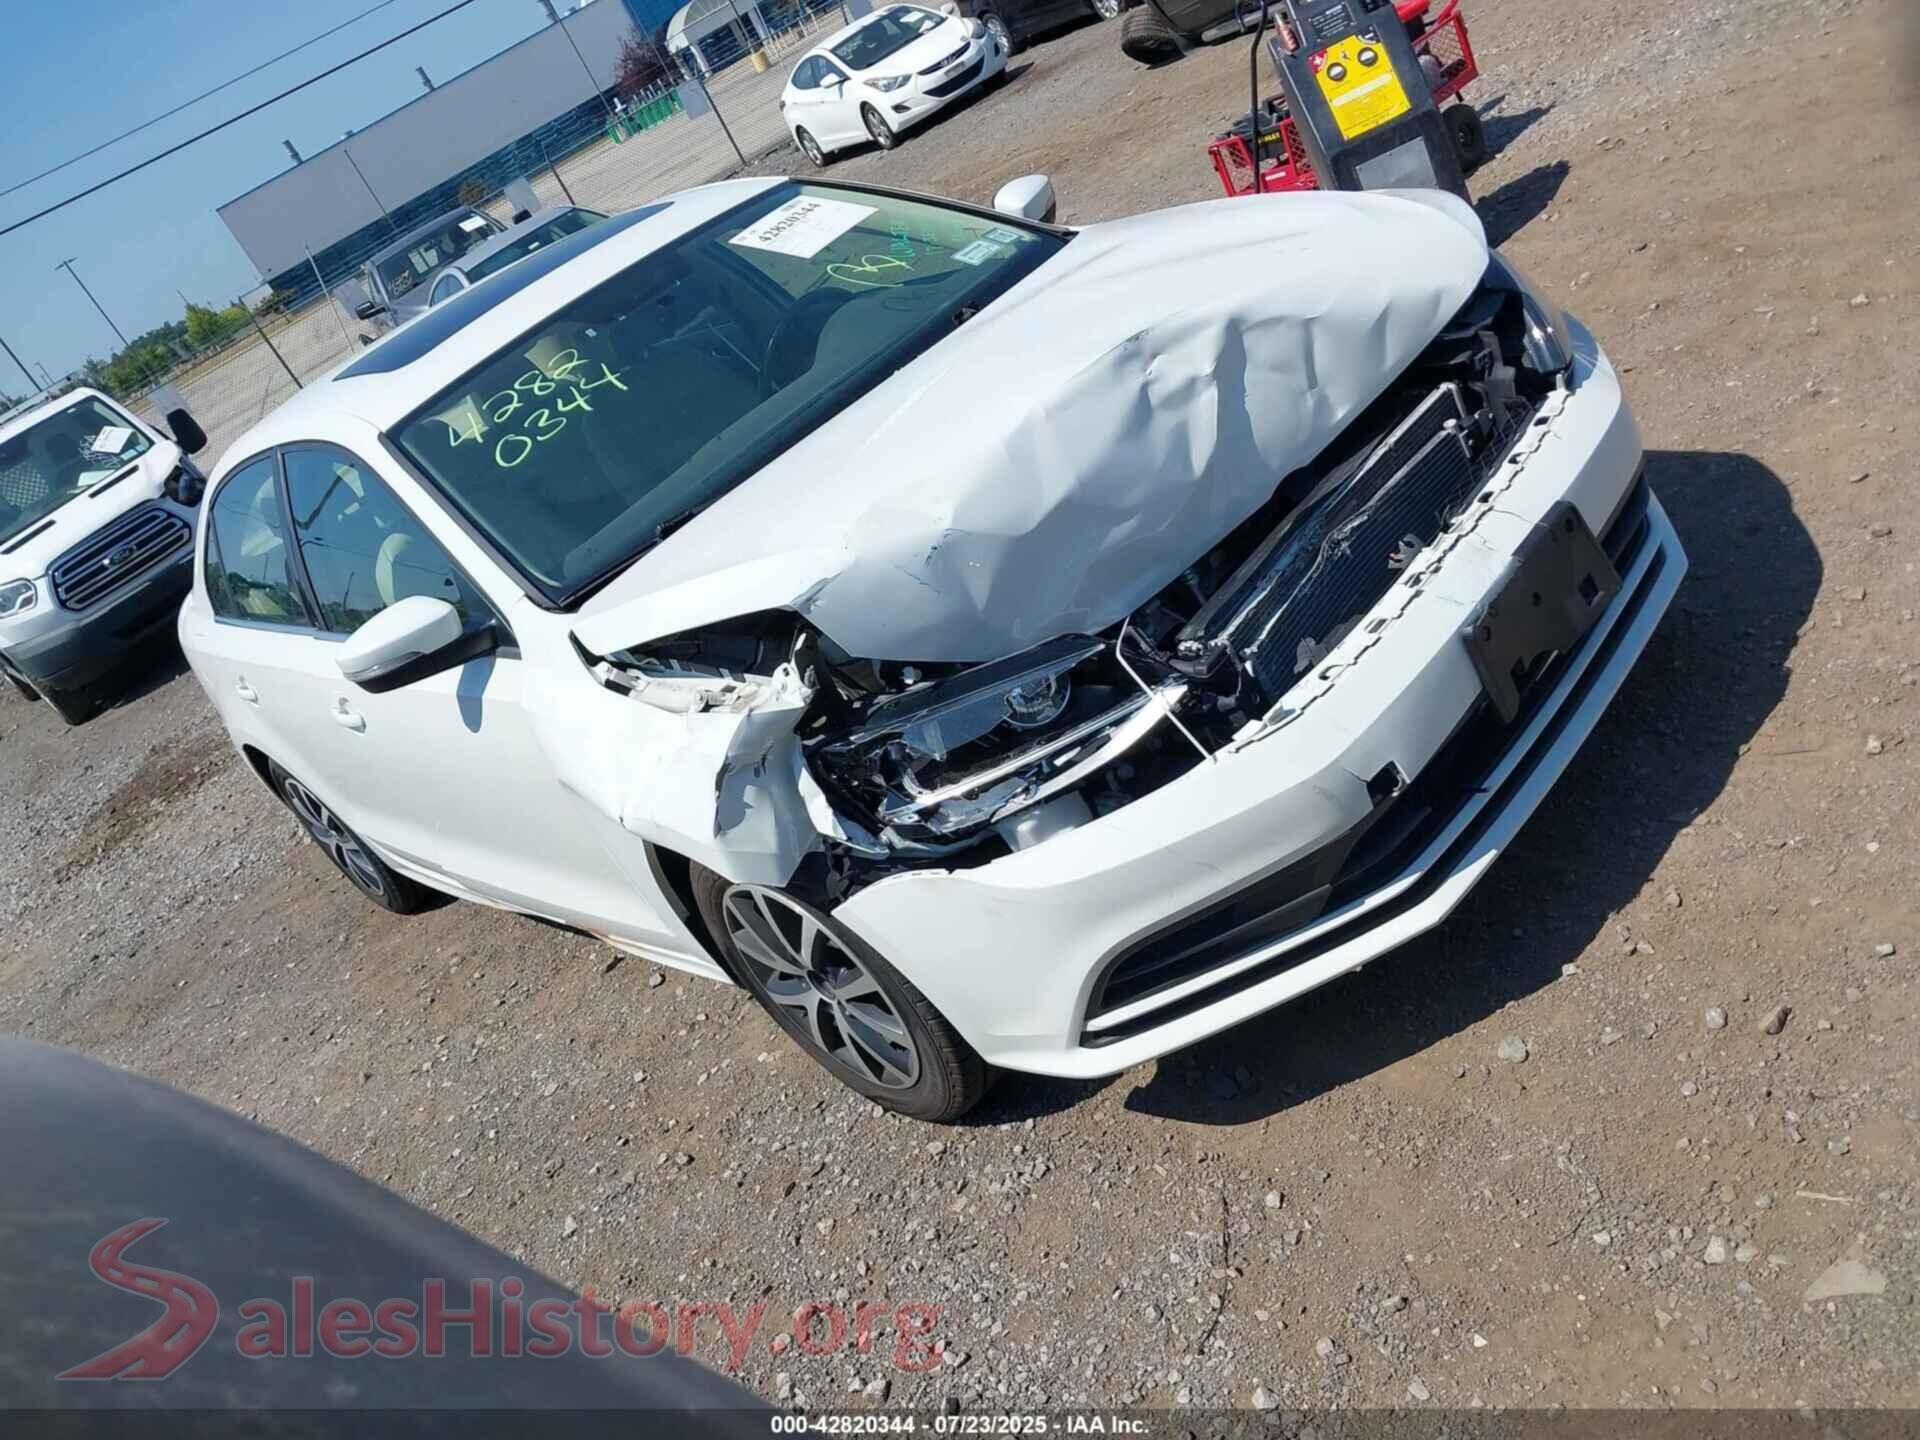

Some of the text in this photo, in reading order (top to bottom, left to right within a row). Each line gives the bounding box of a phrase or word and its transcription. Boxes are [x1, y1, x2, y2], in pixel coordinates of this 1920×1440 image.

[758, 202, 821, 242] 42820344
[449, 348, 591, 447] 4282
[494, 362, 629, 467] 0344
